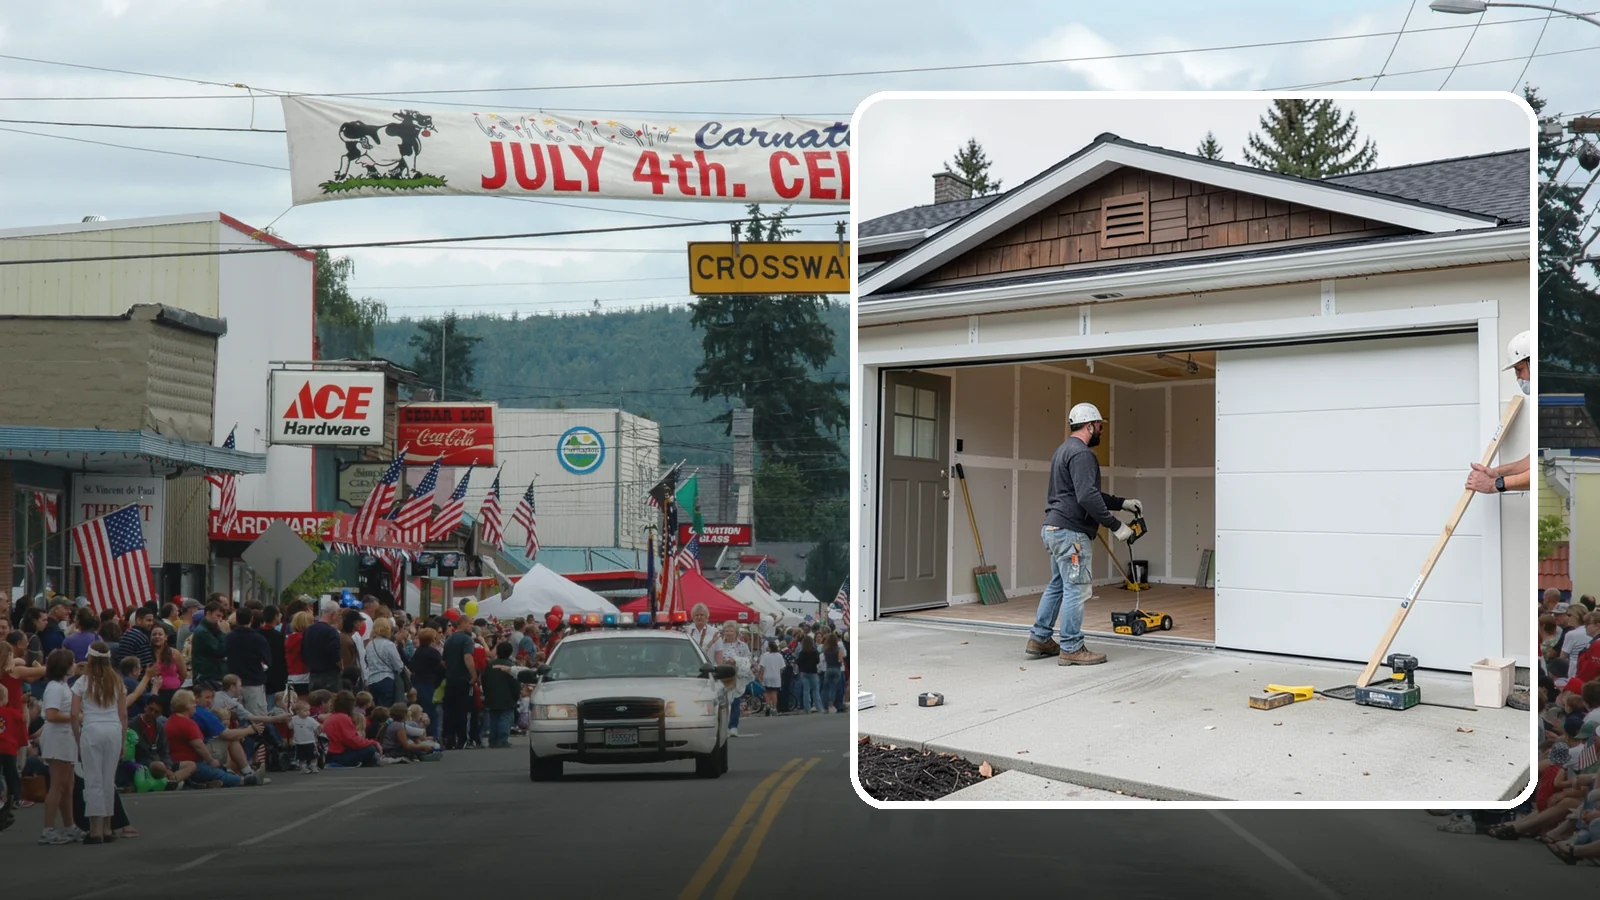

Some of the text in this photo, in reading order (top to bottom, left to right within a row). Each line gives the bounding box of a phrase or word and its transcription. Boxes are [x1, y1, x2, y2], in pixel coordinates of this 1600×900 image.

[695, 121, 850, 150] Carnat
[481, 141, 605, 192] JULY
[632, 150, 746, 198] 4th.
[697, 254, 850, 280] CROSSWA
[283, 380, 373, 420] ACE
[405, 409, 485, 422] CEDAR LOG
[283, 421, 371, 436] Hardware
[416, 428, 477, 447] Coca-Cola
[95, 485, 124, 494] Vincent
[126, 486, 136, 494] de
[138, 485, 155, 495] Paul
[688, 526, 741, 535] CRNATION
[699, 535, 730, 543] GLASS
